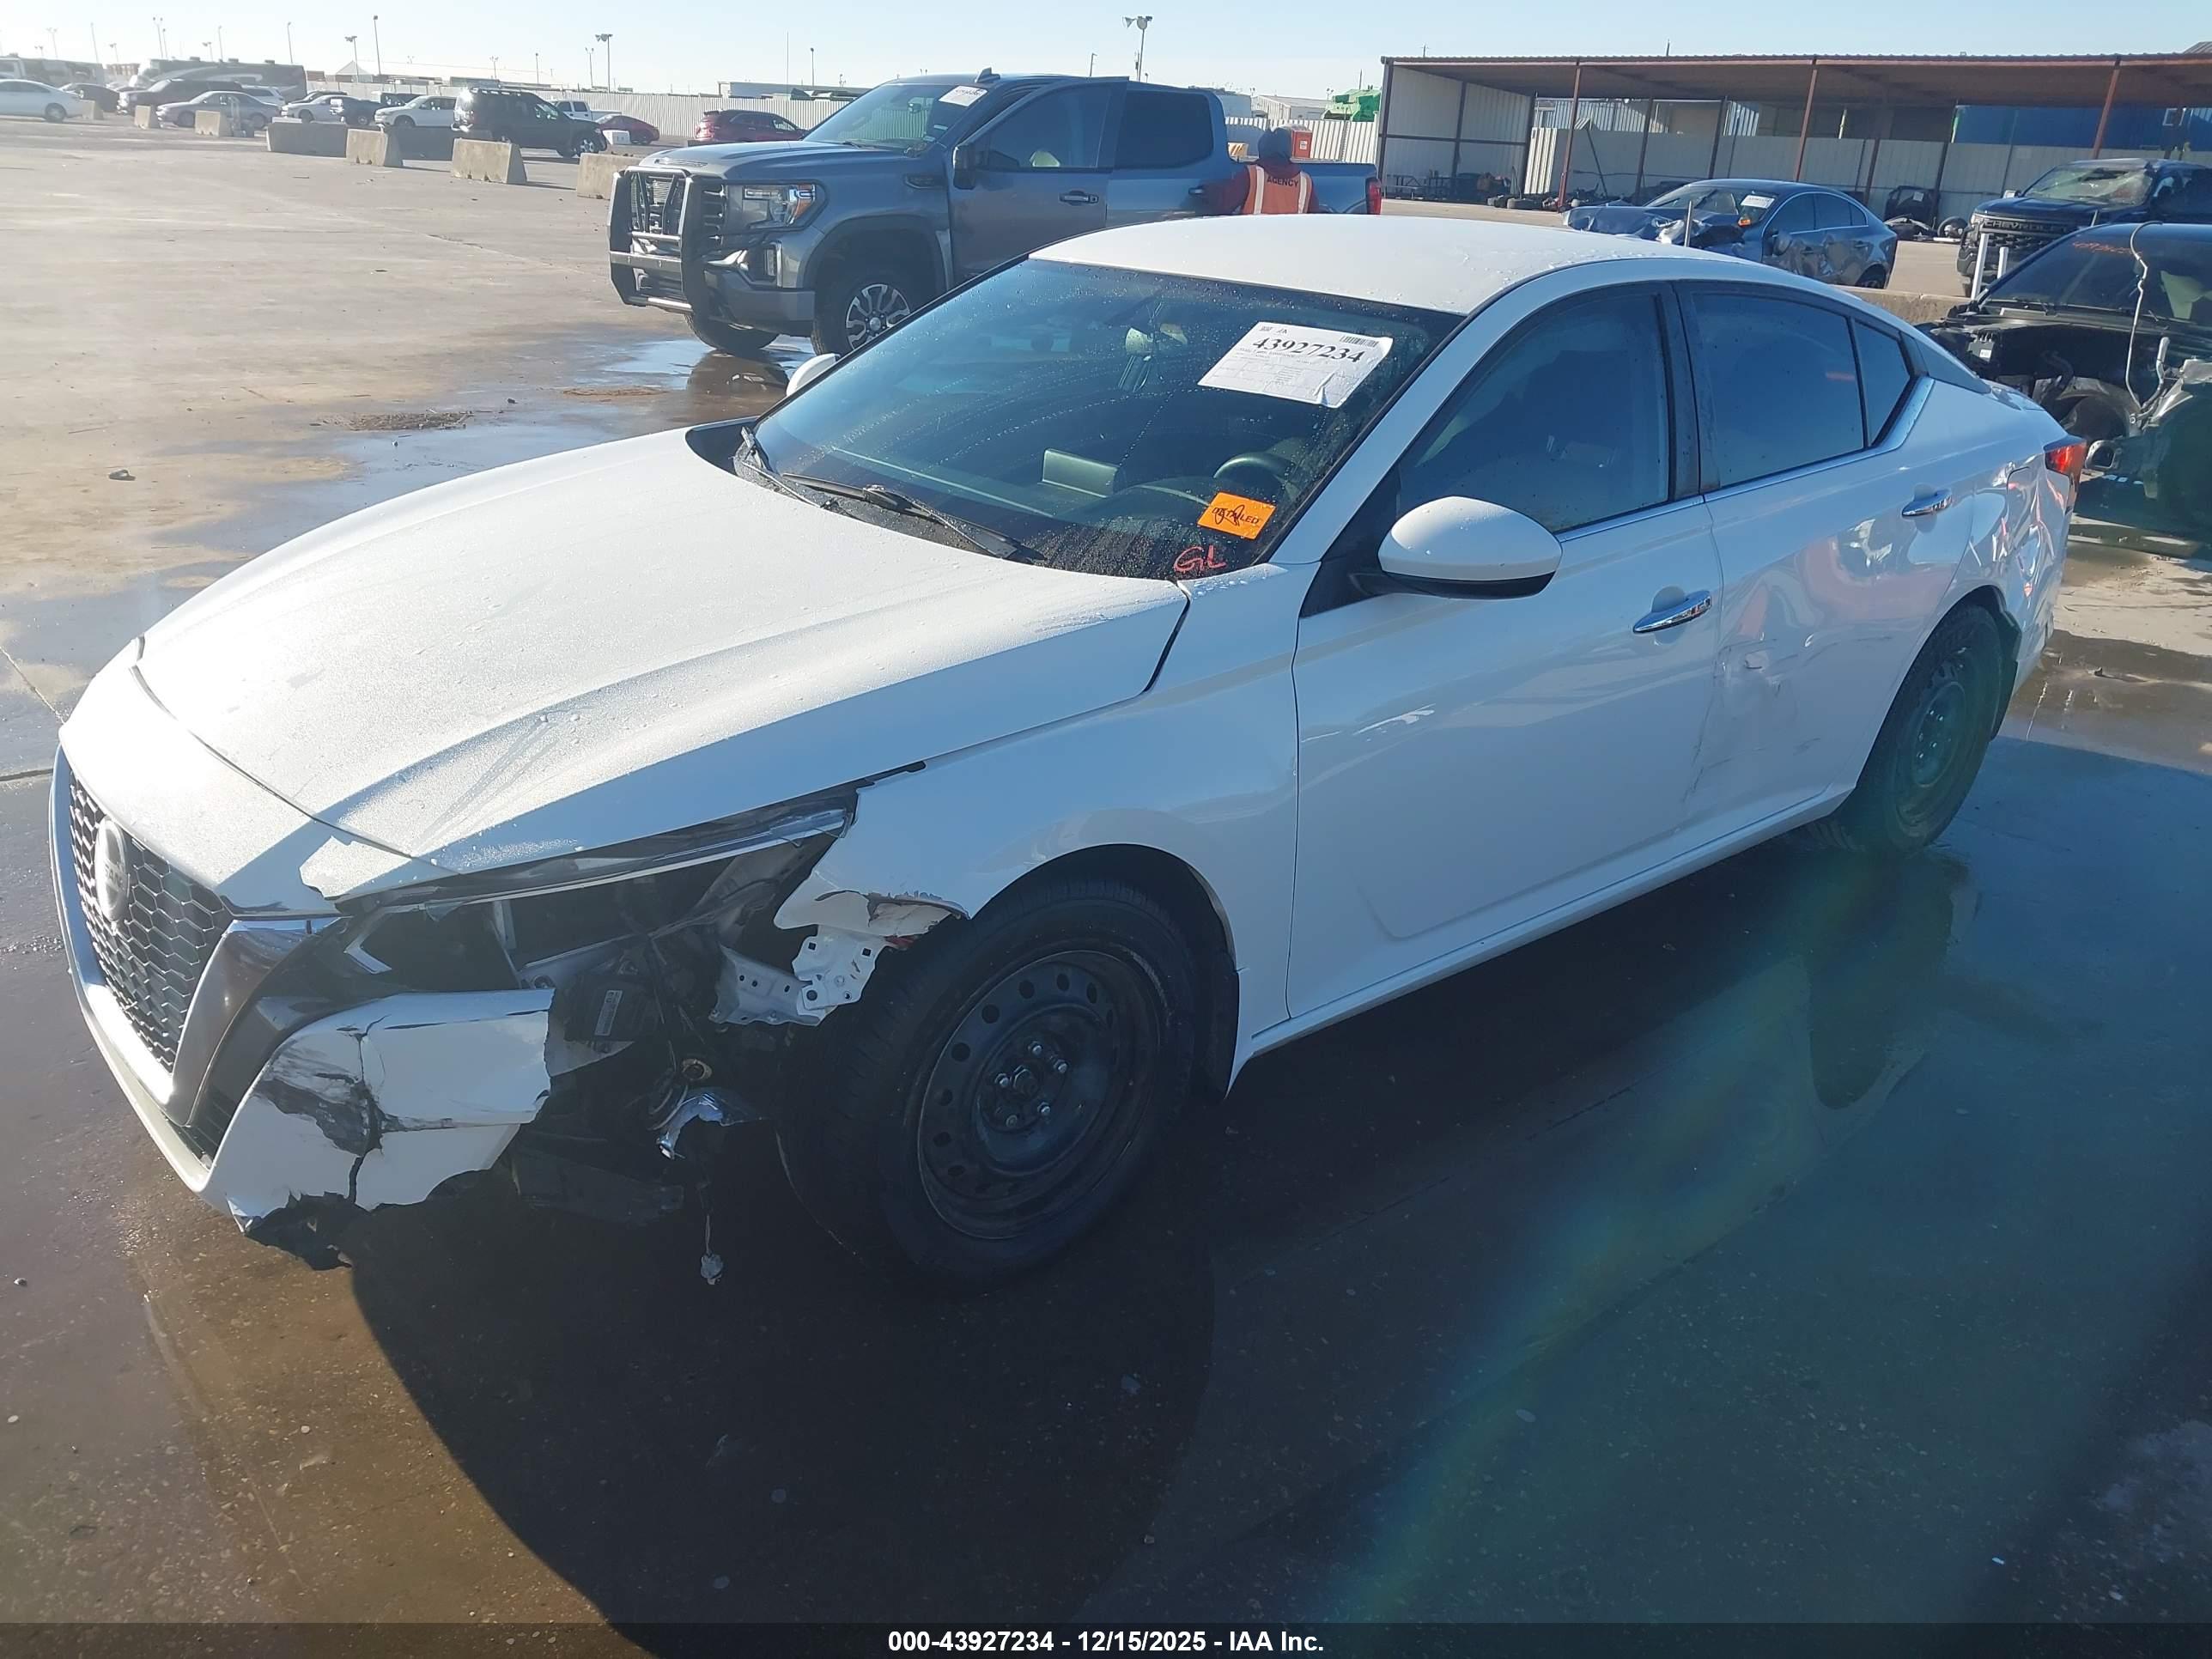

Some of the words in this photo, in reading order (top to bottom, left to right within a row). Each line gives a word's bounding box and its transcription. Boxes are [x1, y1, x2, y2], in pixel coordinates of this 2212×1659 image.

[1267, 175, 1298, 187] AGENCY
[1253, 337, 1364, 362] 43927234
[1212, 507, 1260, 524] DETAILED
